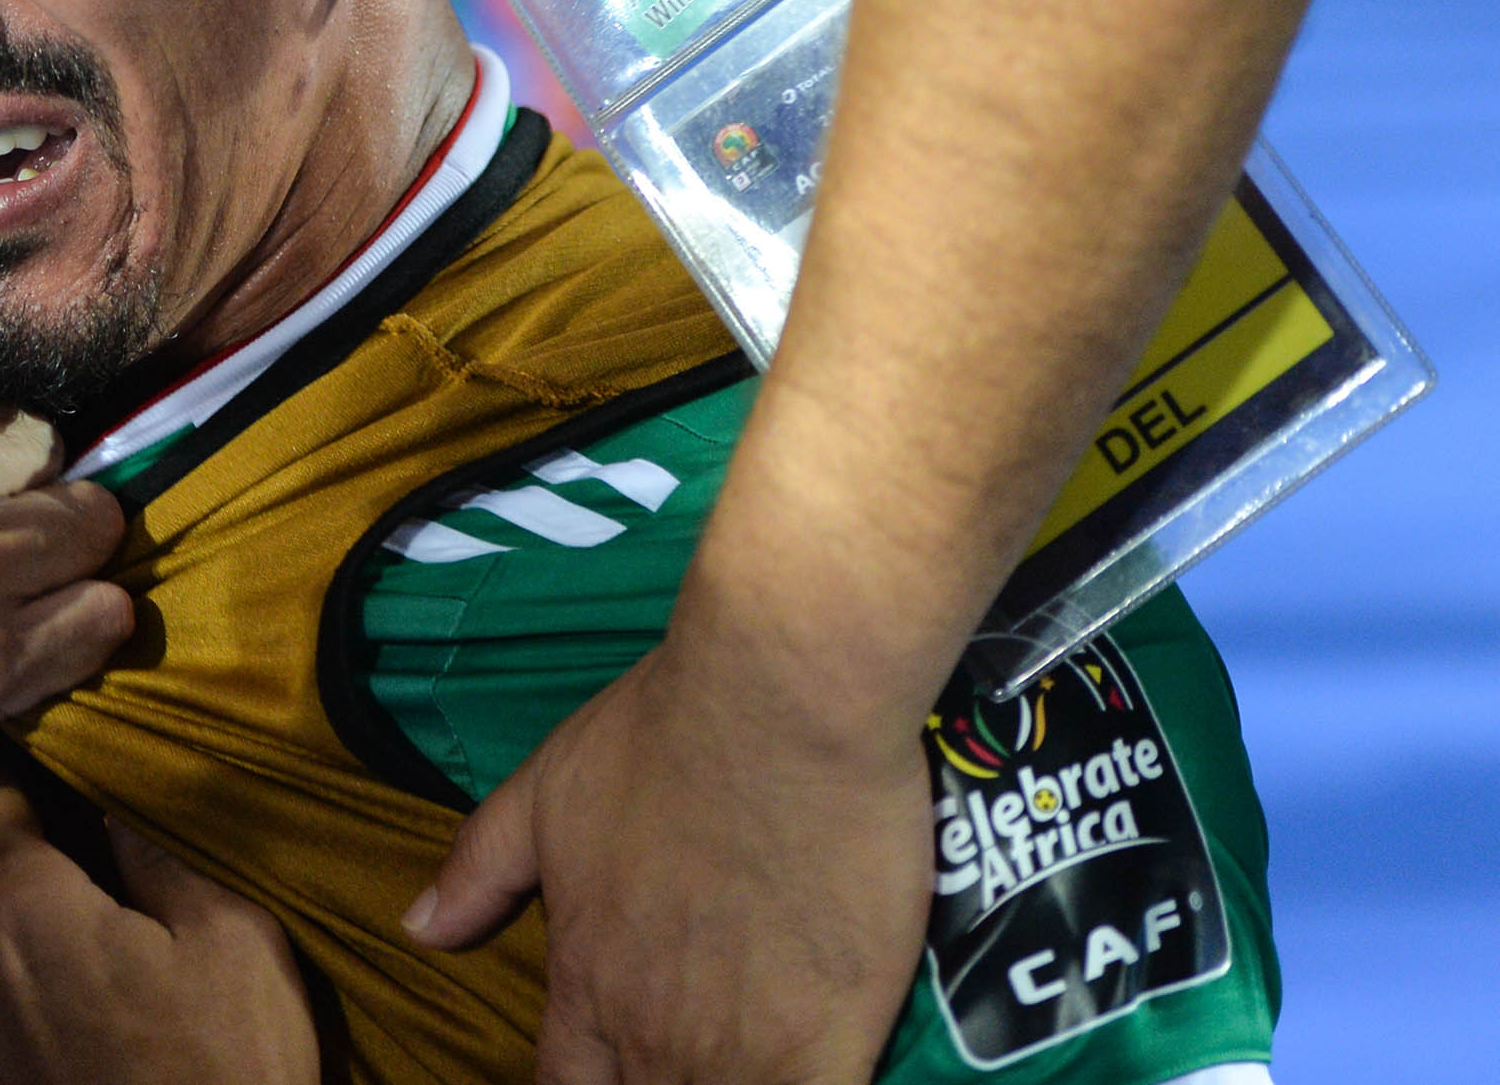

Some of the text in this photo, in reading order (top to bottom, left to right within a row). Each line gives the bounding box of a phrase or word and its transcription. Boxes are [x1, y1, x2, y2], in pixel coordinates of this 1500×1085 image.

[1095, 389, 1208, 475] DEL
[981, 800, 1140, 912] Africa
[1008, 899, 1181, 1006] CAF
